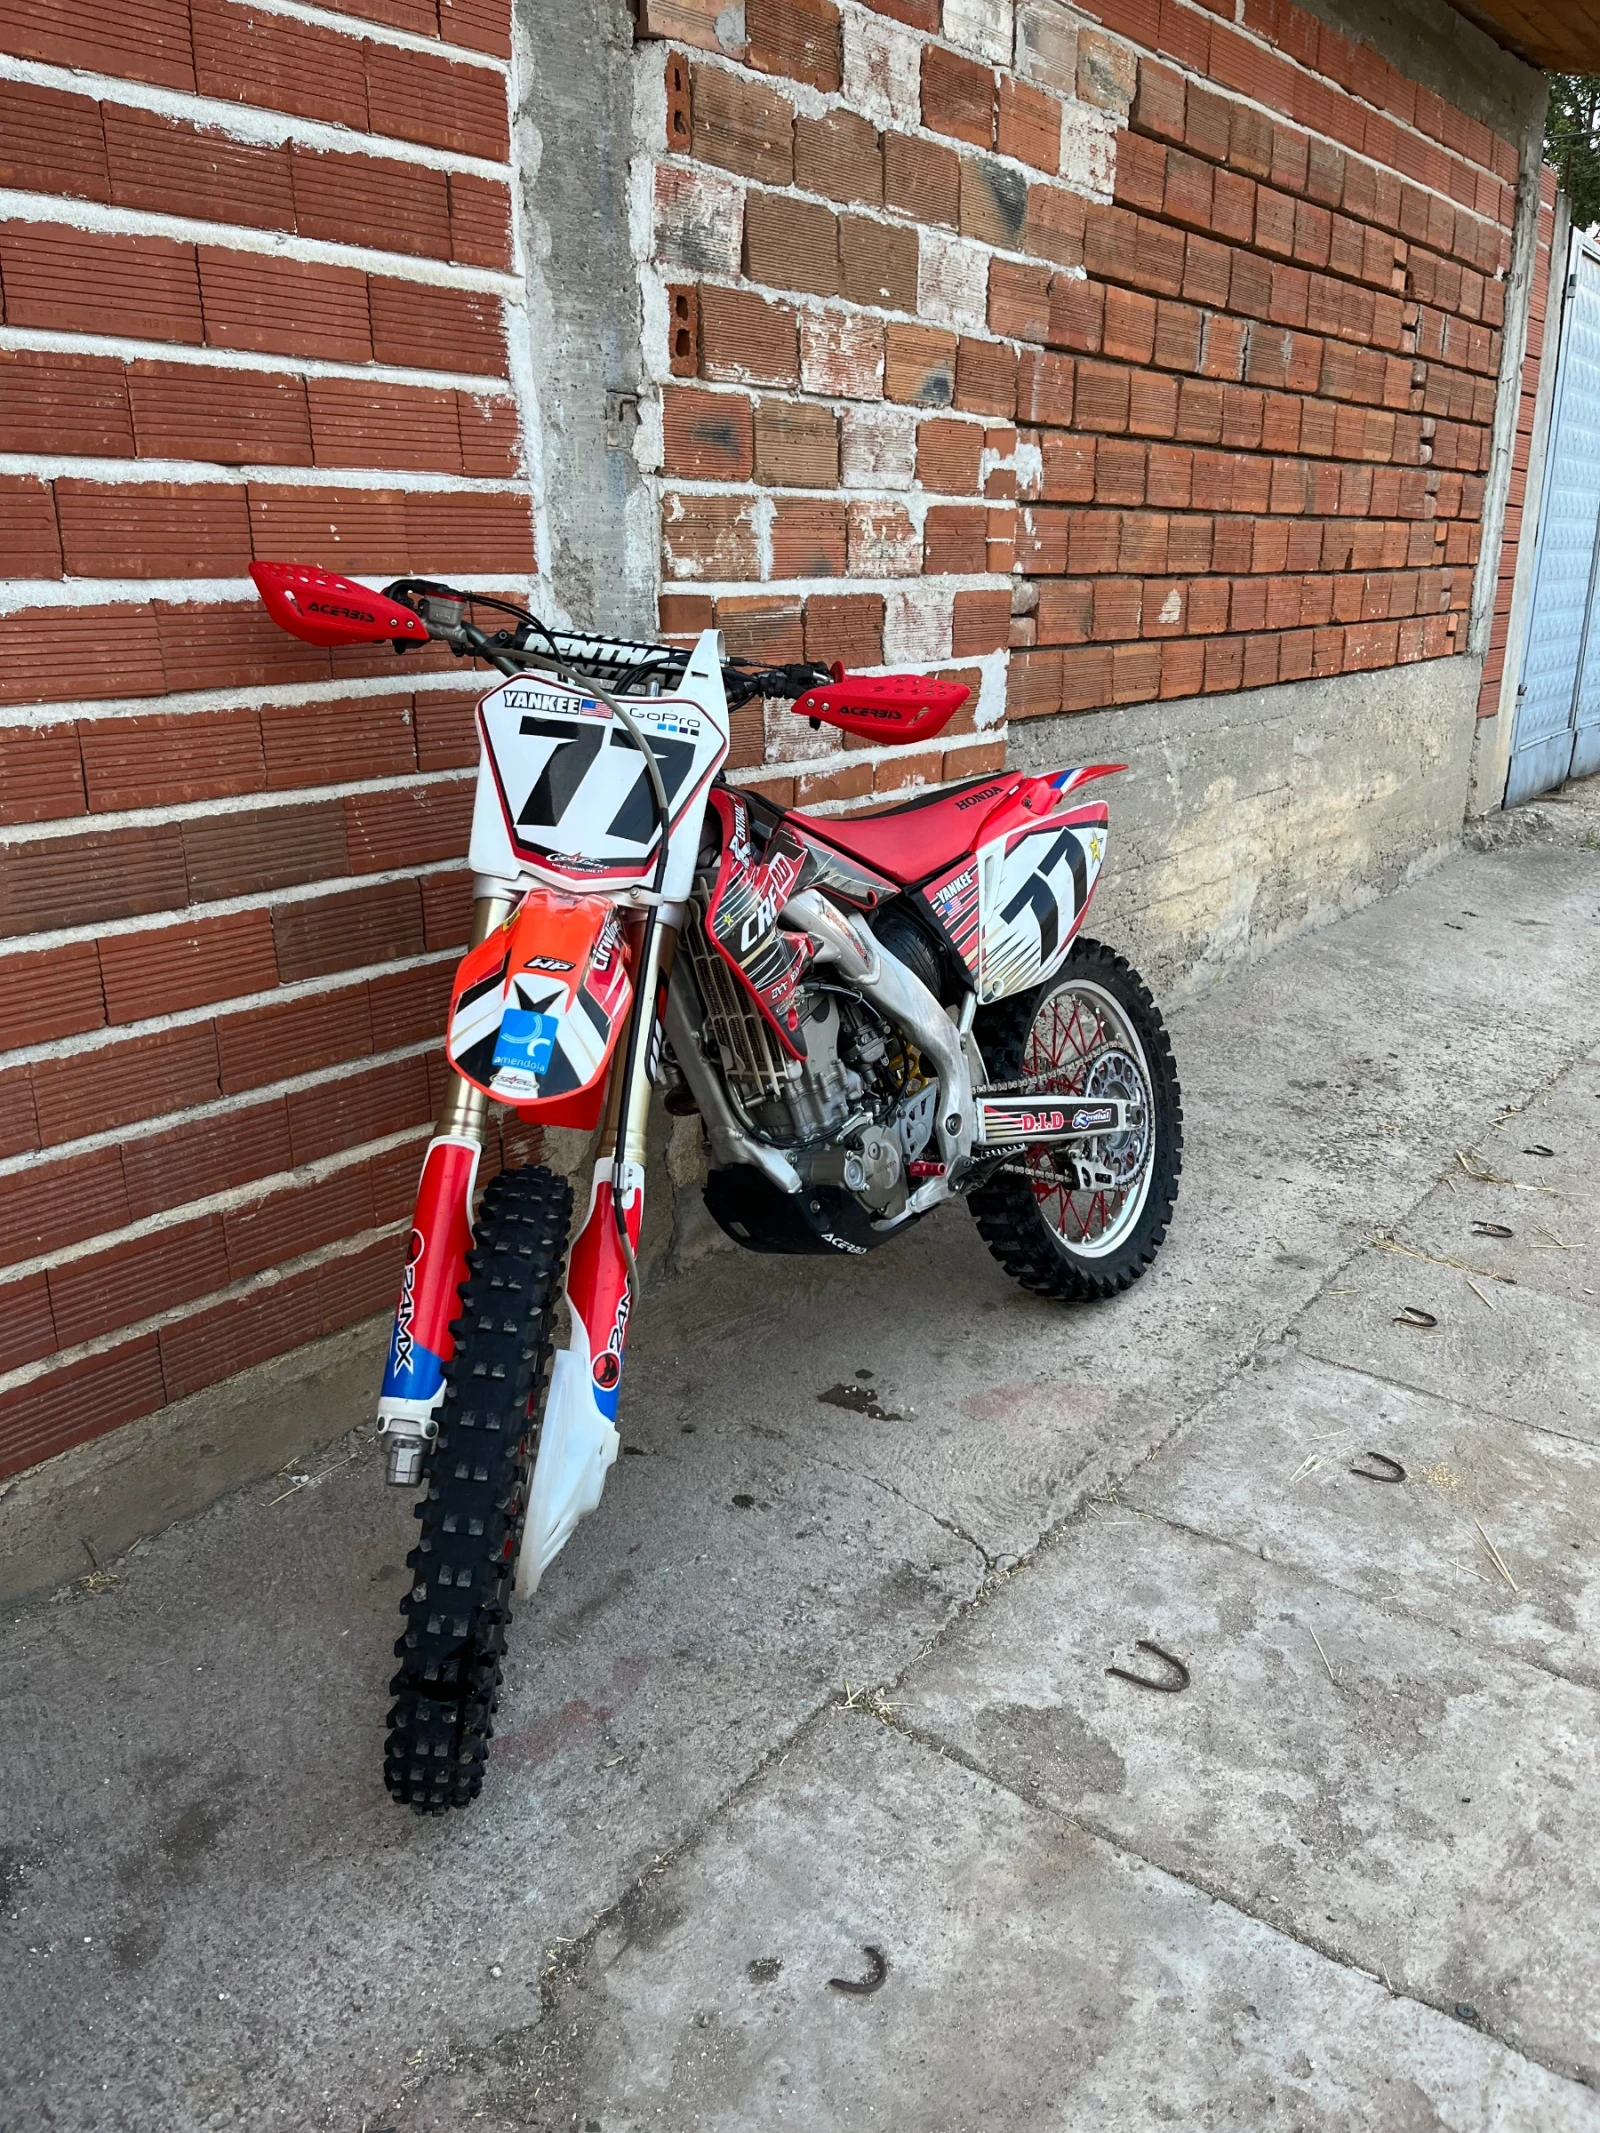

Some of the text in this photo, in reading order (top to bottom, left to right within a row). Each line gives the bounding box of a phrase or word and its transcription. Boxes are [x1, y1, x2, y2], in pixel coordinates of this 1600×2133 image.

[307, 601, 376, 623] ACERBIS
[504, 690, 580, 715] YANKEE
[838, 705, 902, 720] ACERBIS
[629, 707, 701, 728] GoPro
[516, 716, 696, 845] 77
[955, 785, 1004, 810] HONDA
[936, 871, 973, 903] YANKEE
[1000, 828, 1087, 967] 77
[741, 884, 777, 952] CRF
[527, 958, 572, 971] WP
[1021, 1111, 1065, 1131] D.I.D
